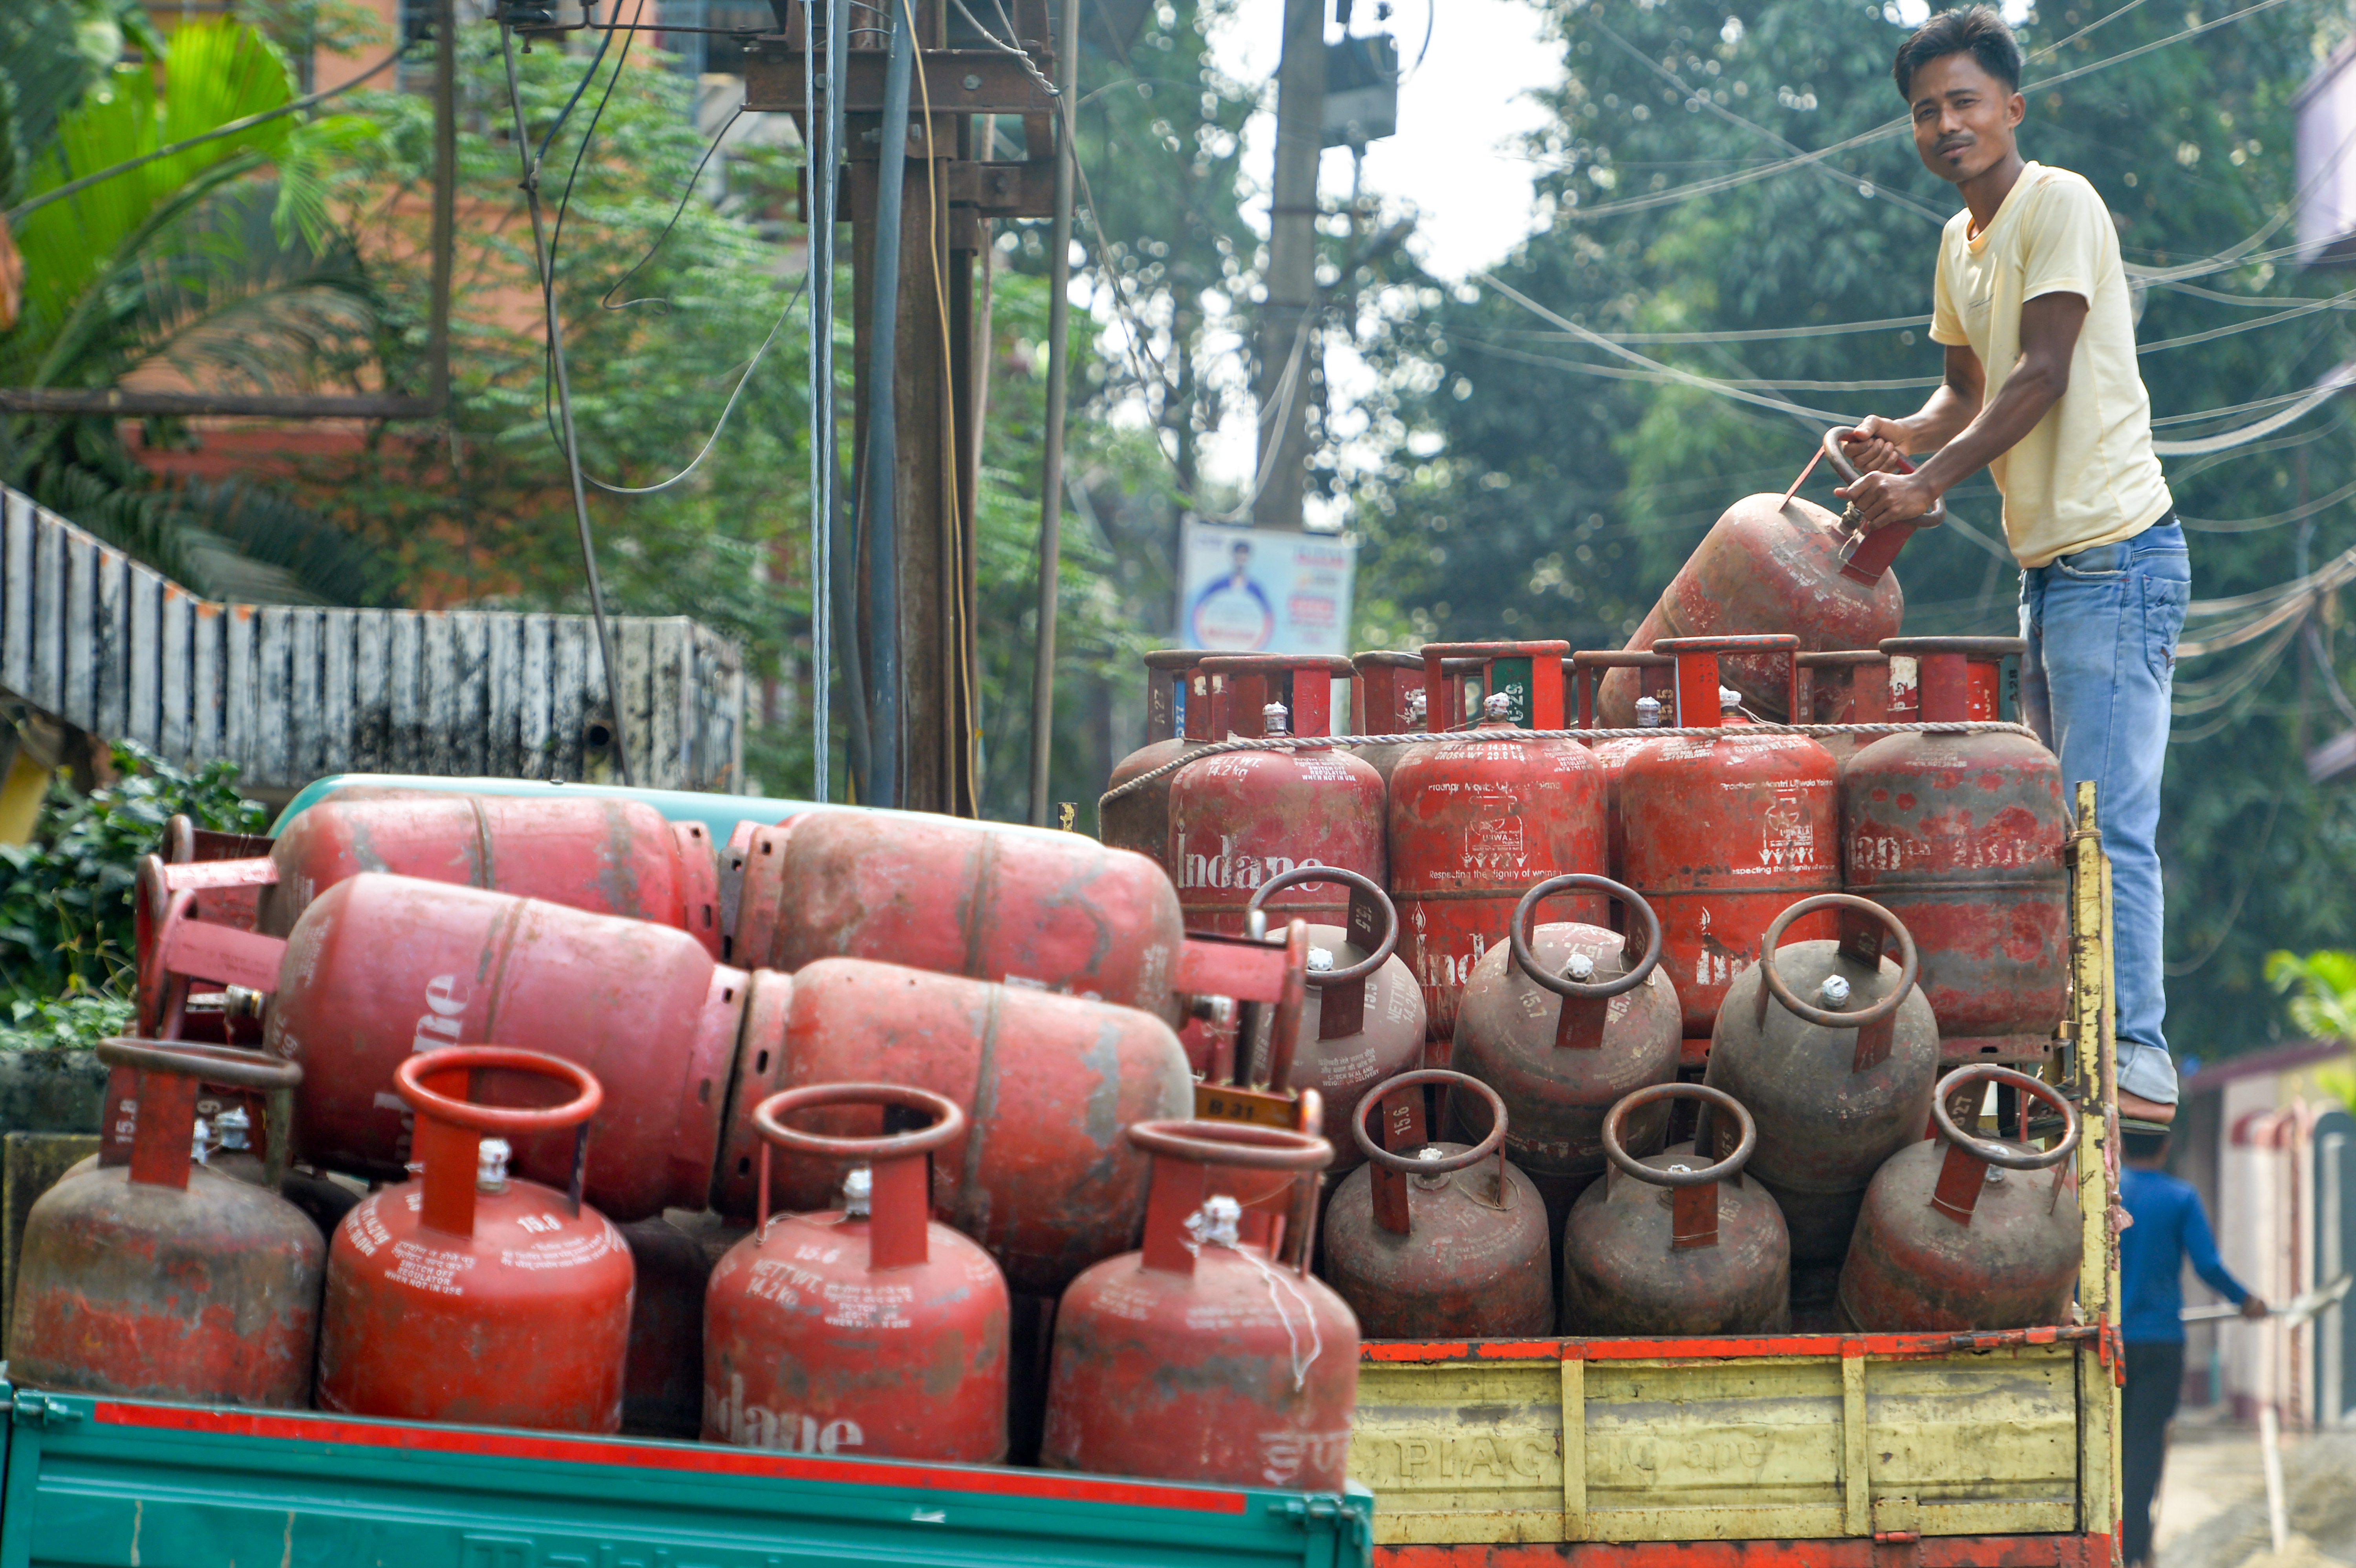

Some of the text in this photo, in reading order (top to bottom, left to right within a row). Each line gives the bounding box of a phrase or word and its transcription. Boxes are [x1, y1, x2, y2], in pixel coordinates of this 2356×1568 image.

[1519, 989, 1547, 1018] 15.7
[1393, 1106, 1412, 1135] 15.6
[517, 1215, 561, 1233] 15.8
[384, 1268, 463, 1296] WHEN NOT IN USE
[397, 1266, 450, 1286] REGULATOR
[400, 1259, 454, 1278] SWITCH OFF
[1394, 1437, 1670, 1477] PIAGIO
